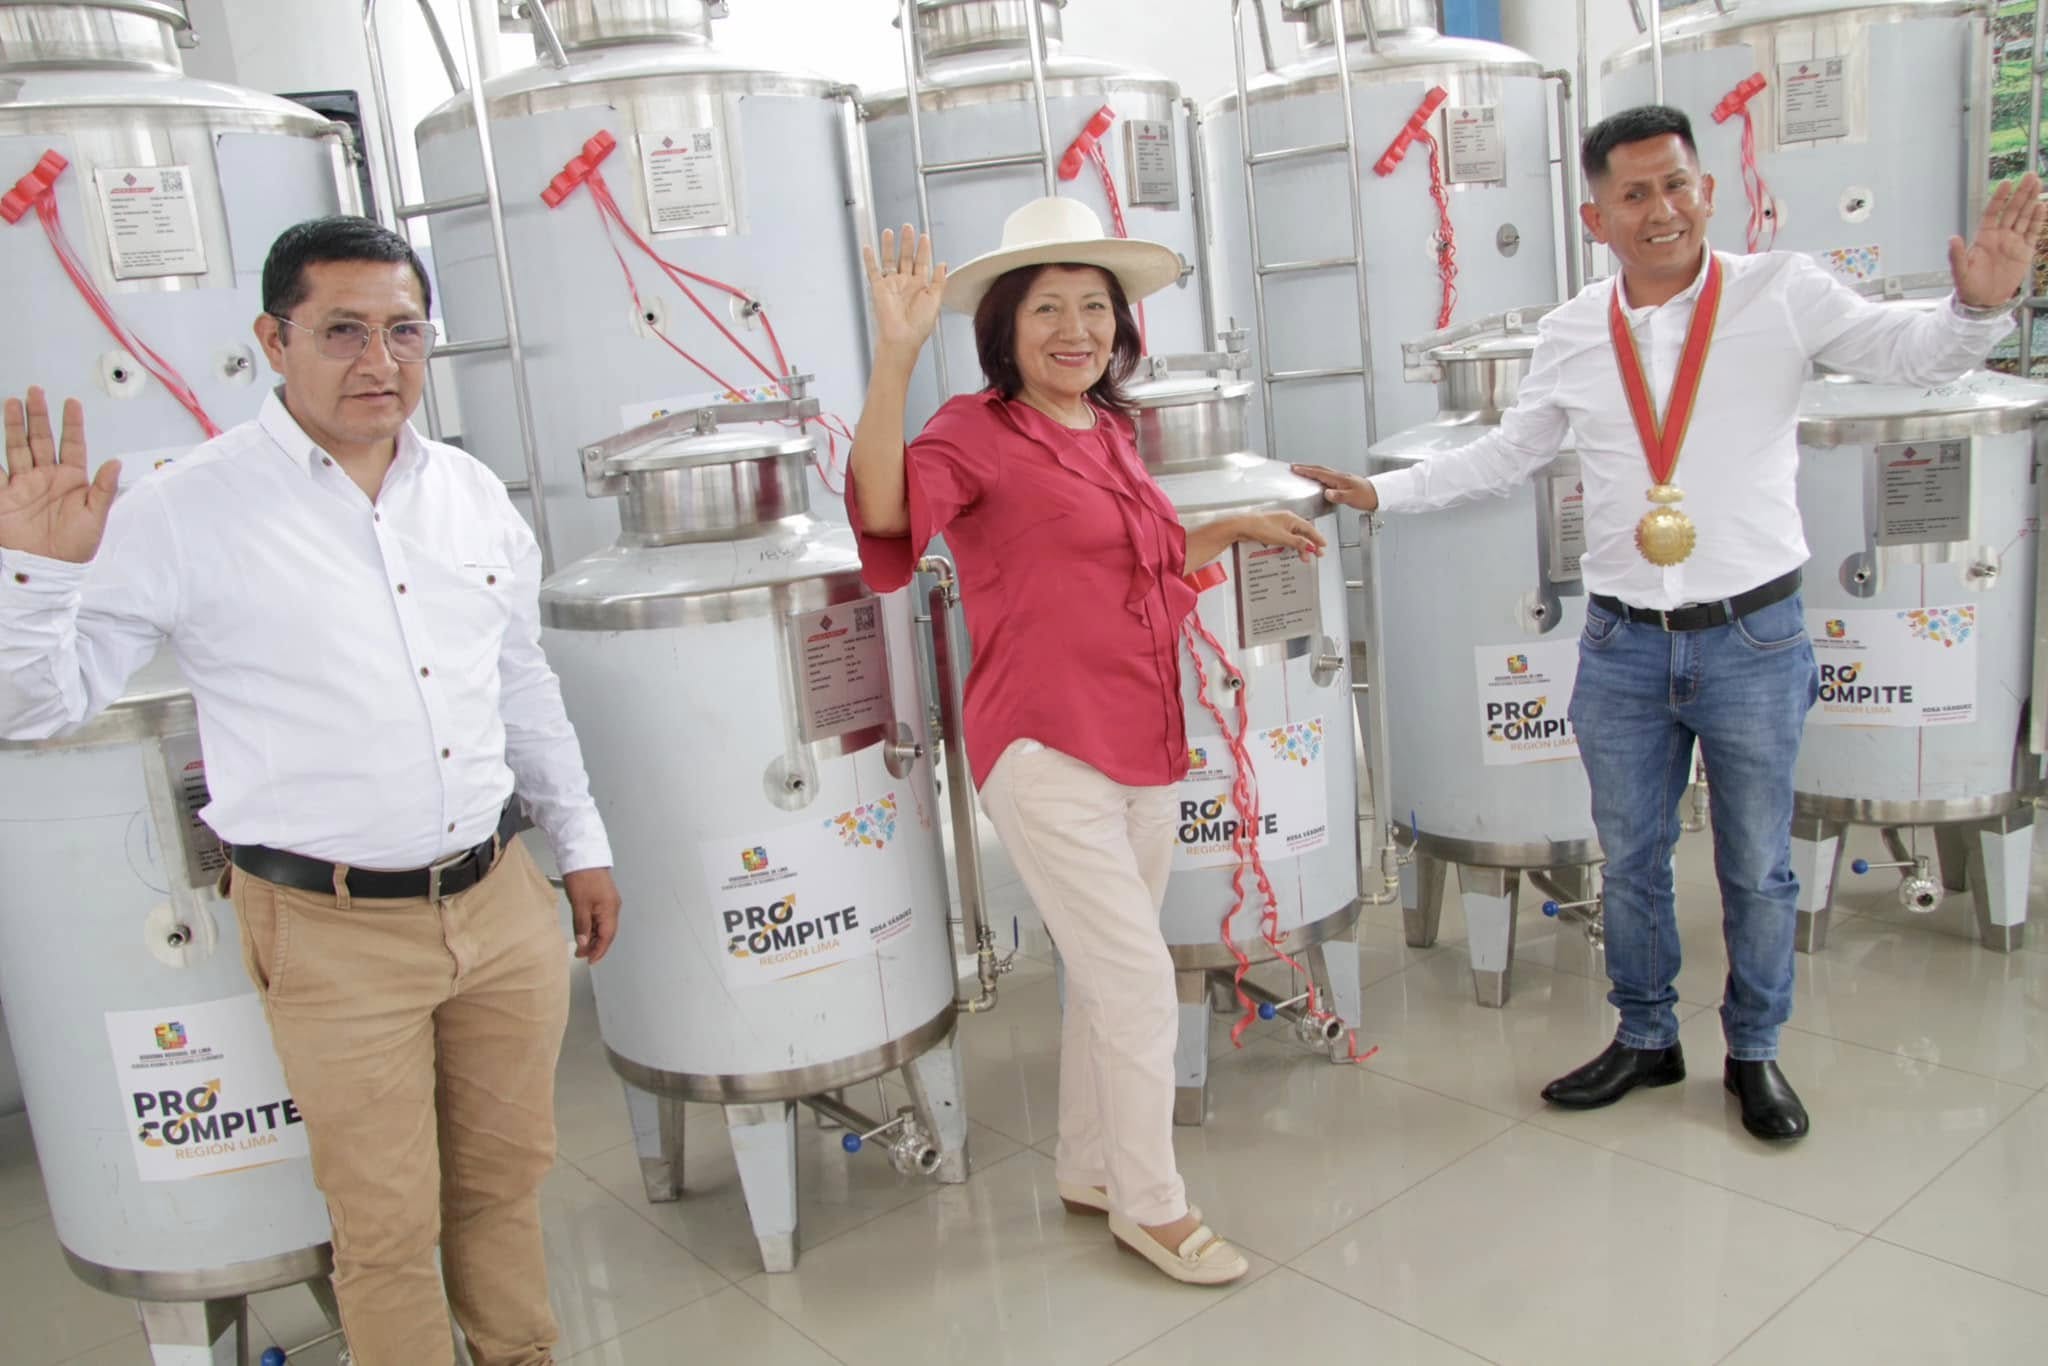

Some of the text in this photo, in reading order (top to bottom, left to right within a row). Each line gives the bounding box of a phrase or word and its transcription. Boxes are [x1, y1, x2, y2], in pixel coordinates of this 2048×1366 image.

[1821, 664, 1857, 684] RO
[1819, 684, 1913, 704] OMPITE
[1487, 701, 1543, 721] PRO
[1180, 799, 1222, 821] RO
[723, 902, 794, 933] PRO
[729, 906, 860, 958] COMPITE
[811, 939, 840, 955] LIMA
[133, 1086, 218, 1119] PRO
[139, 1098, 303, 1147] COMPITE
[240, 1134, 278, 1150] LIMA
